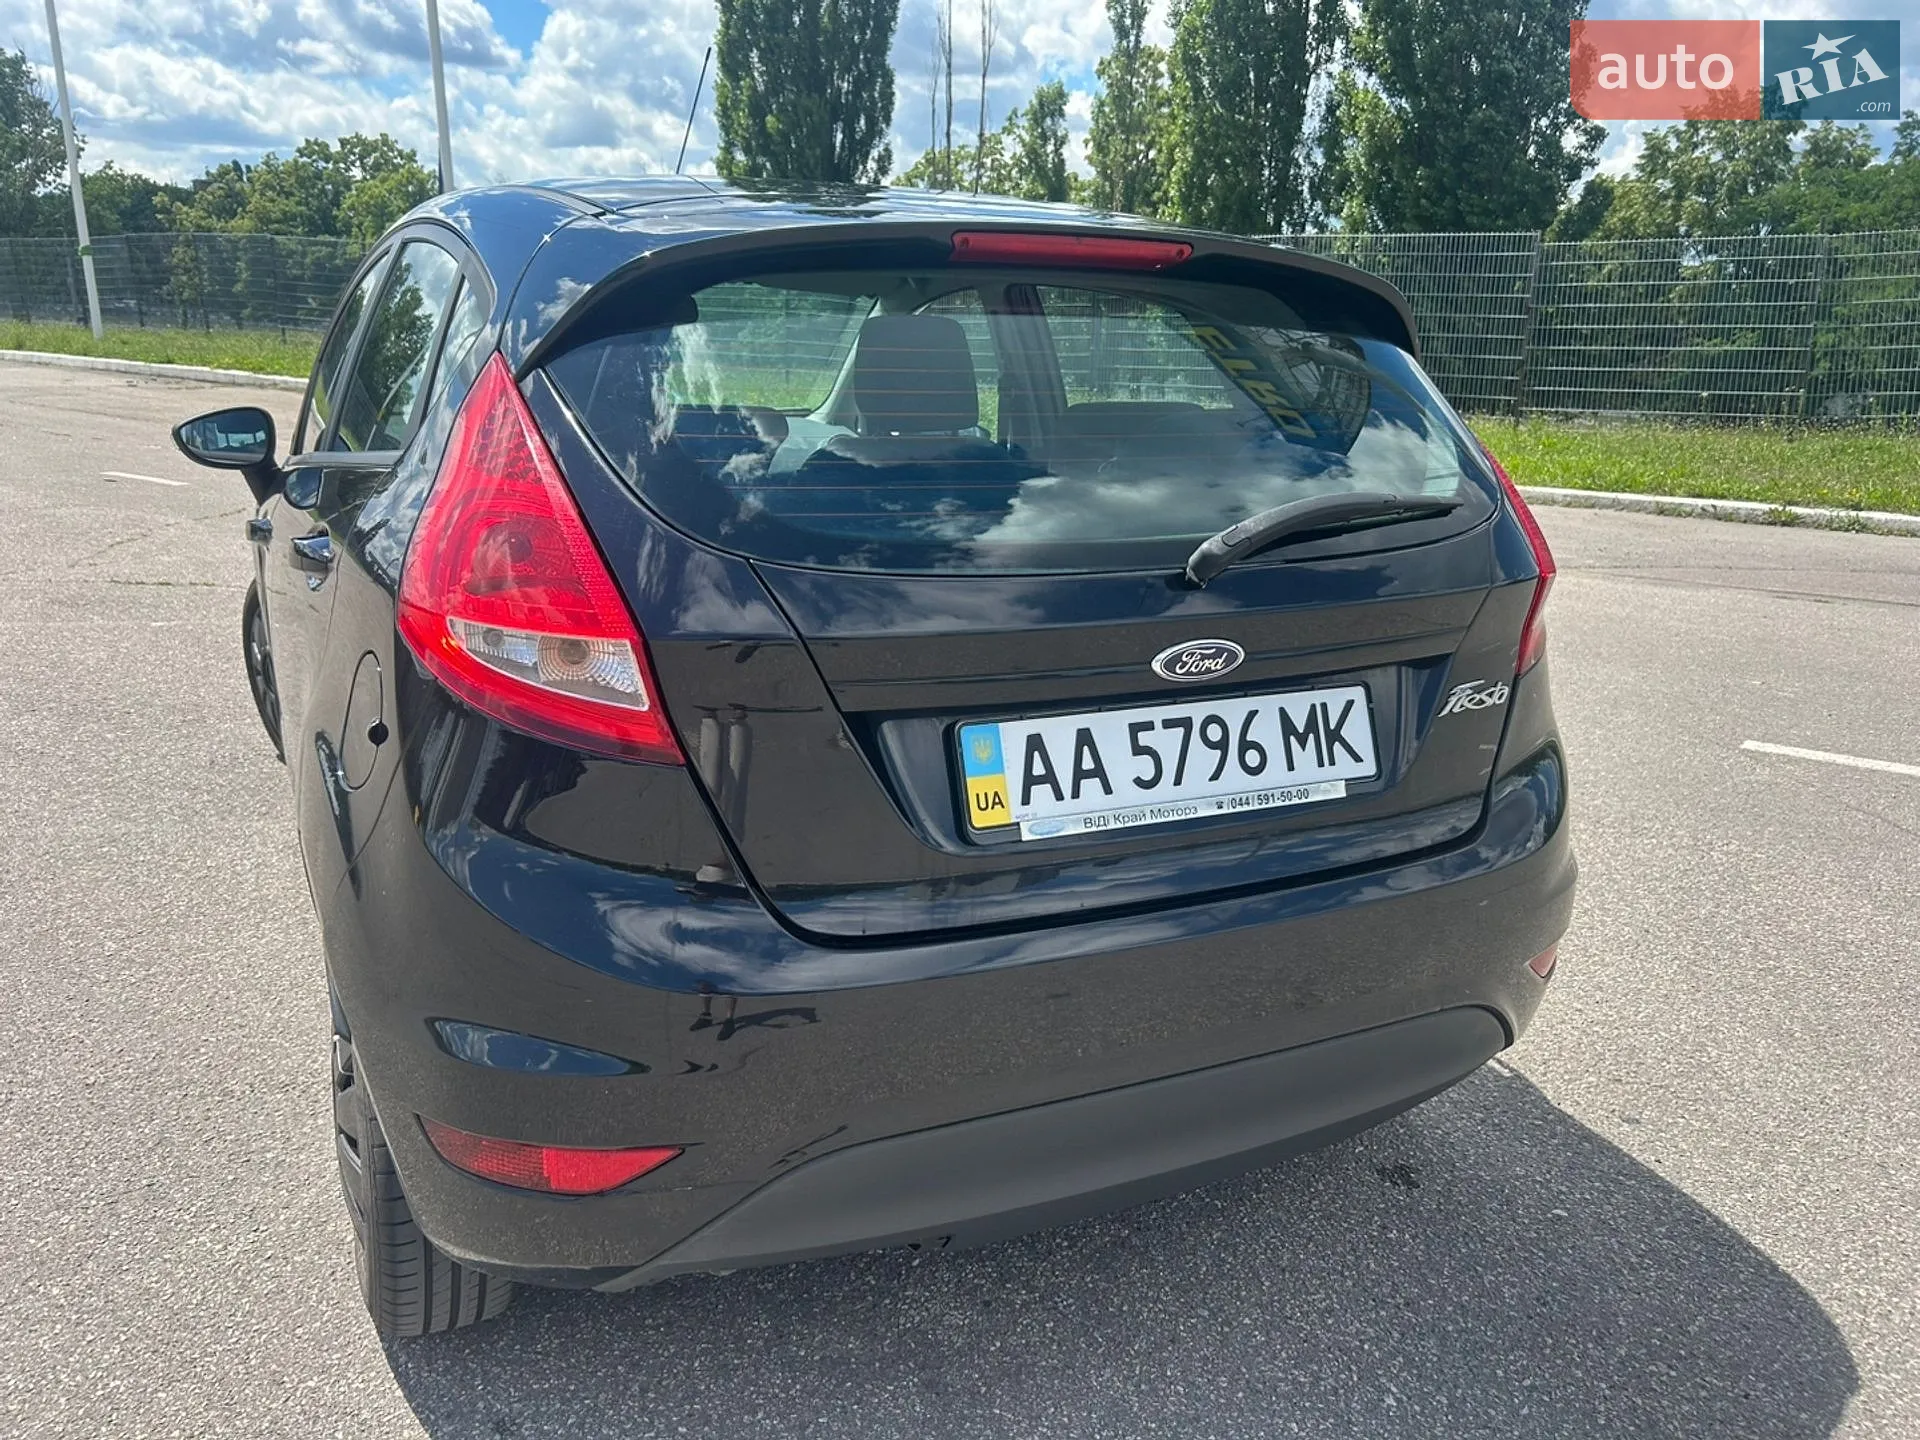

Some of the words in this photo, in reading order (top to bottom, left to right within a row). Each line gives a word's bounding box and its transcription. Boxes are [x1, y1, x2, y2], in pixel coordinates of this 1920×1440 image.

[1175, 648, 1228, 674] Ford
[1438, 680, 1509, 717] Fiesta
[1020, 728, 1114, 807] AA
[1128, 709, 1268, 791] 5796
[1278, 699, 1365, 772] MK
[976, 790, 1006, 812] UA
[1113, 810, 1147, 827] Край
[1150, 805, 1199, 822] Моторз
[1257, 788, 1310, 806] 591-50-00
